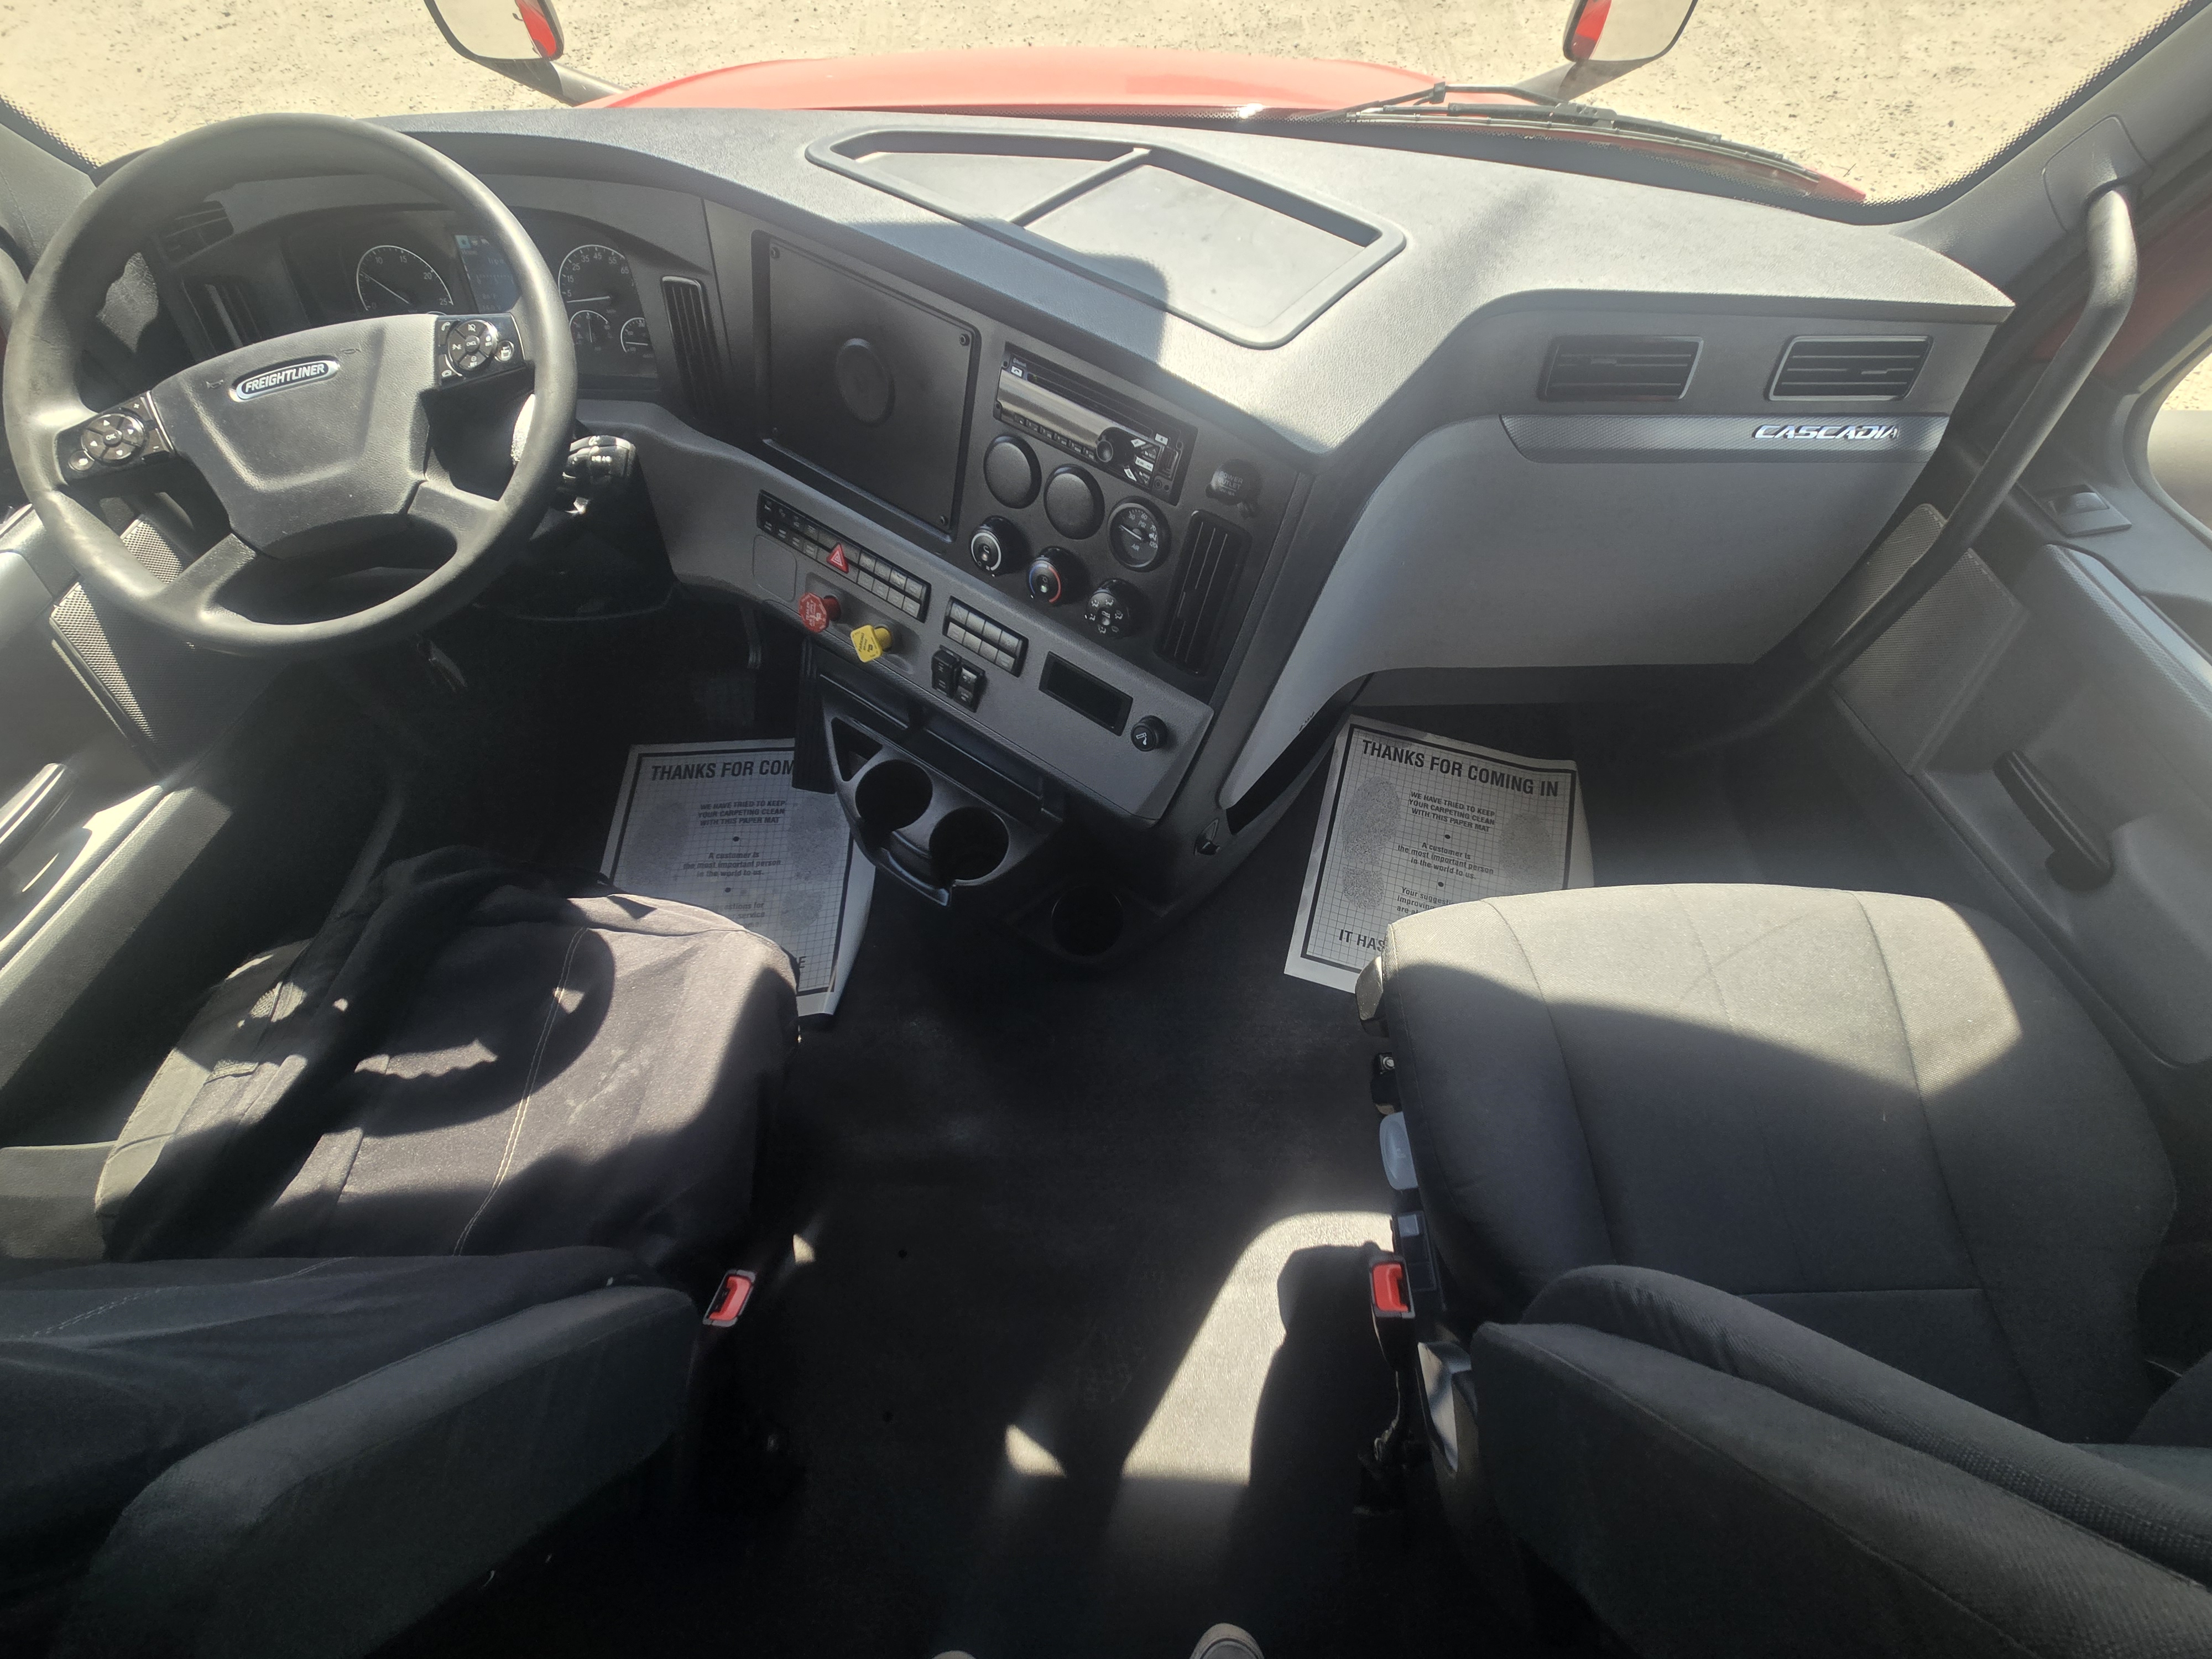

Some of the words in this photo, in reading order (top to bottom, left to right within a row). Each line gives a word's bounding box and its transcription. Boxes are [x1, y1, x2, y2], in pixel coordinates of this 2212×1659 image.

[572, 263, 580, 271] 25
[245, 363, 325, 393] FREIGHTLINER
[1754, 424, 1900, 439] CASCADIA
[1218, 476, 1241, 490] OUTLET
[1219, 471, 1243, 484] POWER
[651, 763, 717, 781] THANKS
[721, 761, 754, 778] FOR
[759, 760, 795, 775] COM
[1363, 739, 1425, 768] THANKS
[1430, 756, 1463, 777] FOR
[1468, 765, 1533, 794] COMING
[1540, 781, 1559, 797] IN
[719, 809, 760, 817] CARPETING
[1409, 799, 1429, 809] YOUR
[1430, 805, 1470, 820] CARPETING
[1472, 815, 1495, 825] CLEAN
[1411, 791, 1422, 800] WE
[1423, 795, 1442, 805] HAVE
[1444, 799, 1464, 810] TRIED
[1467, 805, 1475, 813] TO
[1477, 807, 1495, 817] KEEP
[1411, 807, 1430, 817] WITH
[1432, 812, 1448, 822] THIS
[1450, 818, 1473, 828] PAPER
[1475, 823, 1490, 832] MAT
[1397, 844, 1410, 853] the
[1411, 848, 1430, 859] most
[1431, 853, 1467, 868] important
[1468, 863, 1494, 875] person
[1429, 845, 1463, 858] customer
[718, 860, 754, 869] important
[1411, 857, 1418, 865] in
[1420, 859, 1432, 868] the
[1433, 863, 1454, 874] world
[1465, 872, 1477, 880] us.
[1397, 895, 1436, 909] improvin
[1401, 886, 1418, 897] Your
[1420, 892, 1456, 905] suggesti
[1397, 905, 1409, 914] are
[1339, 929, 1353, 943] IT
[1357, 934, 1385, 952] HAS
